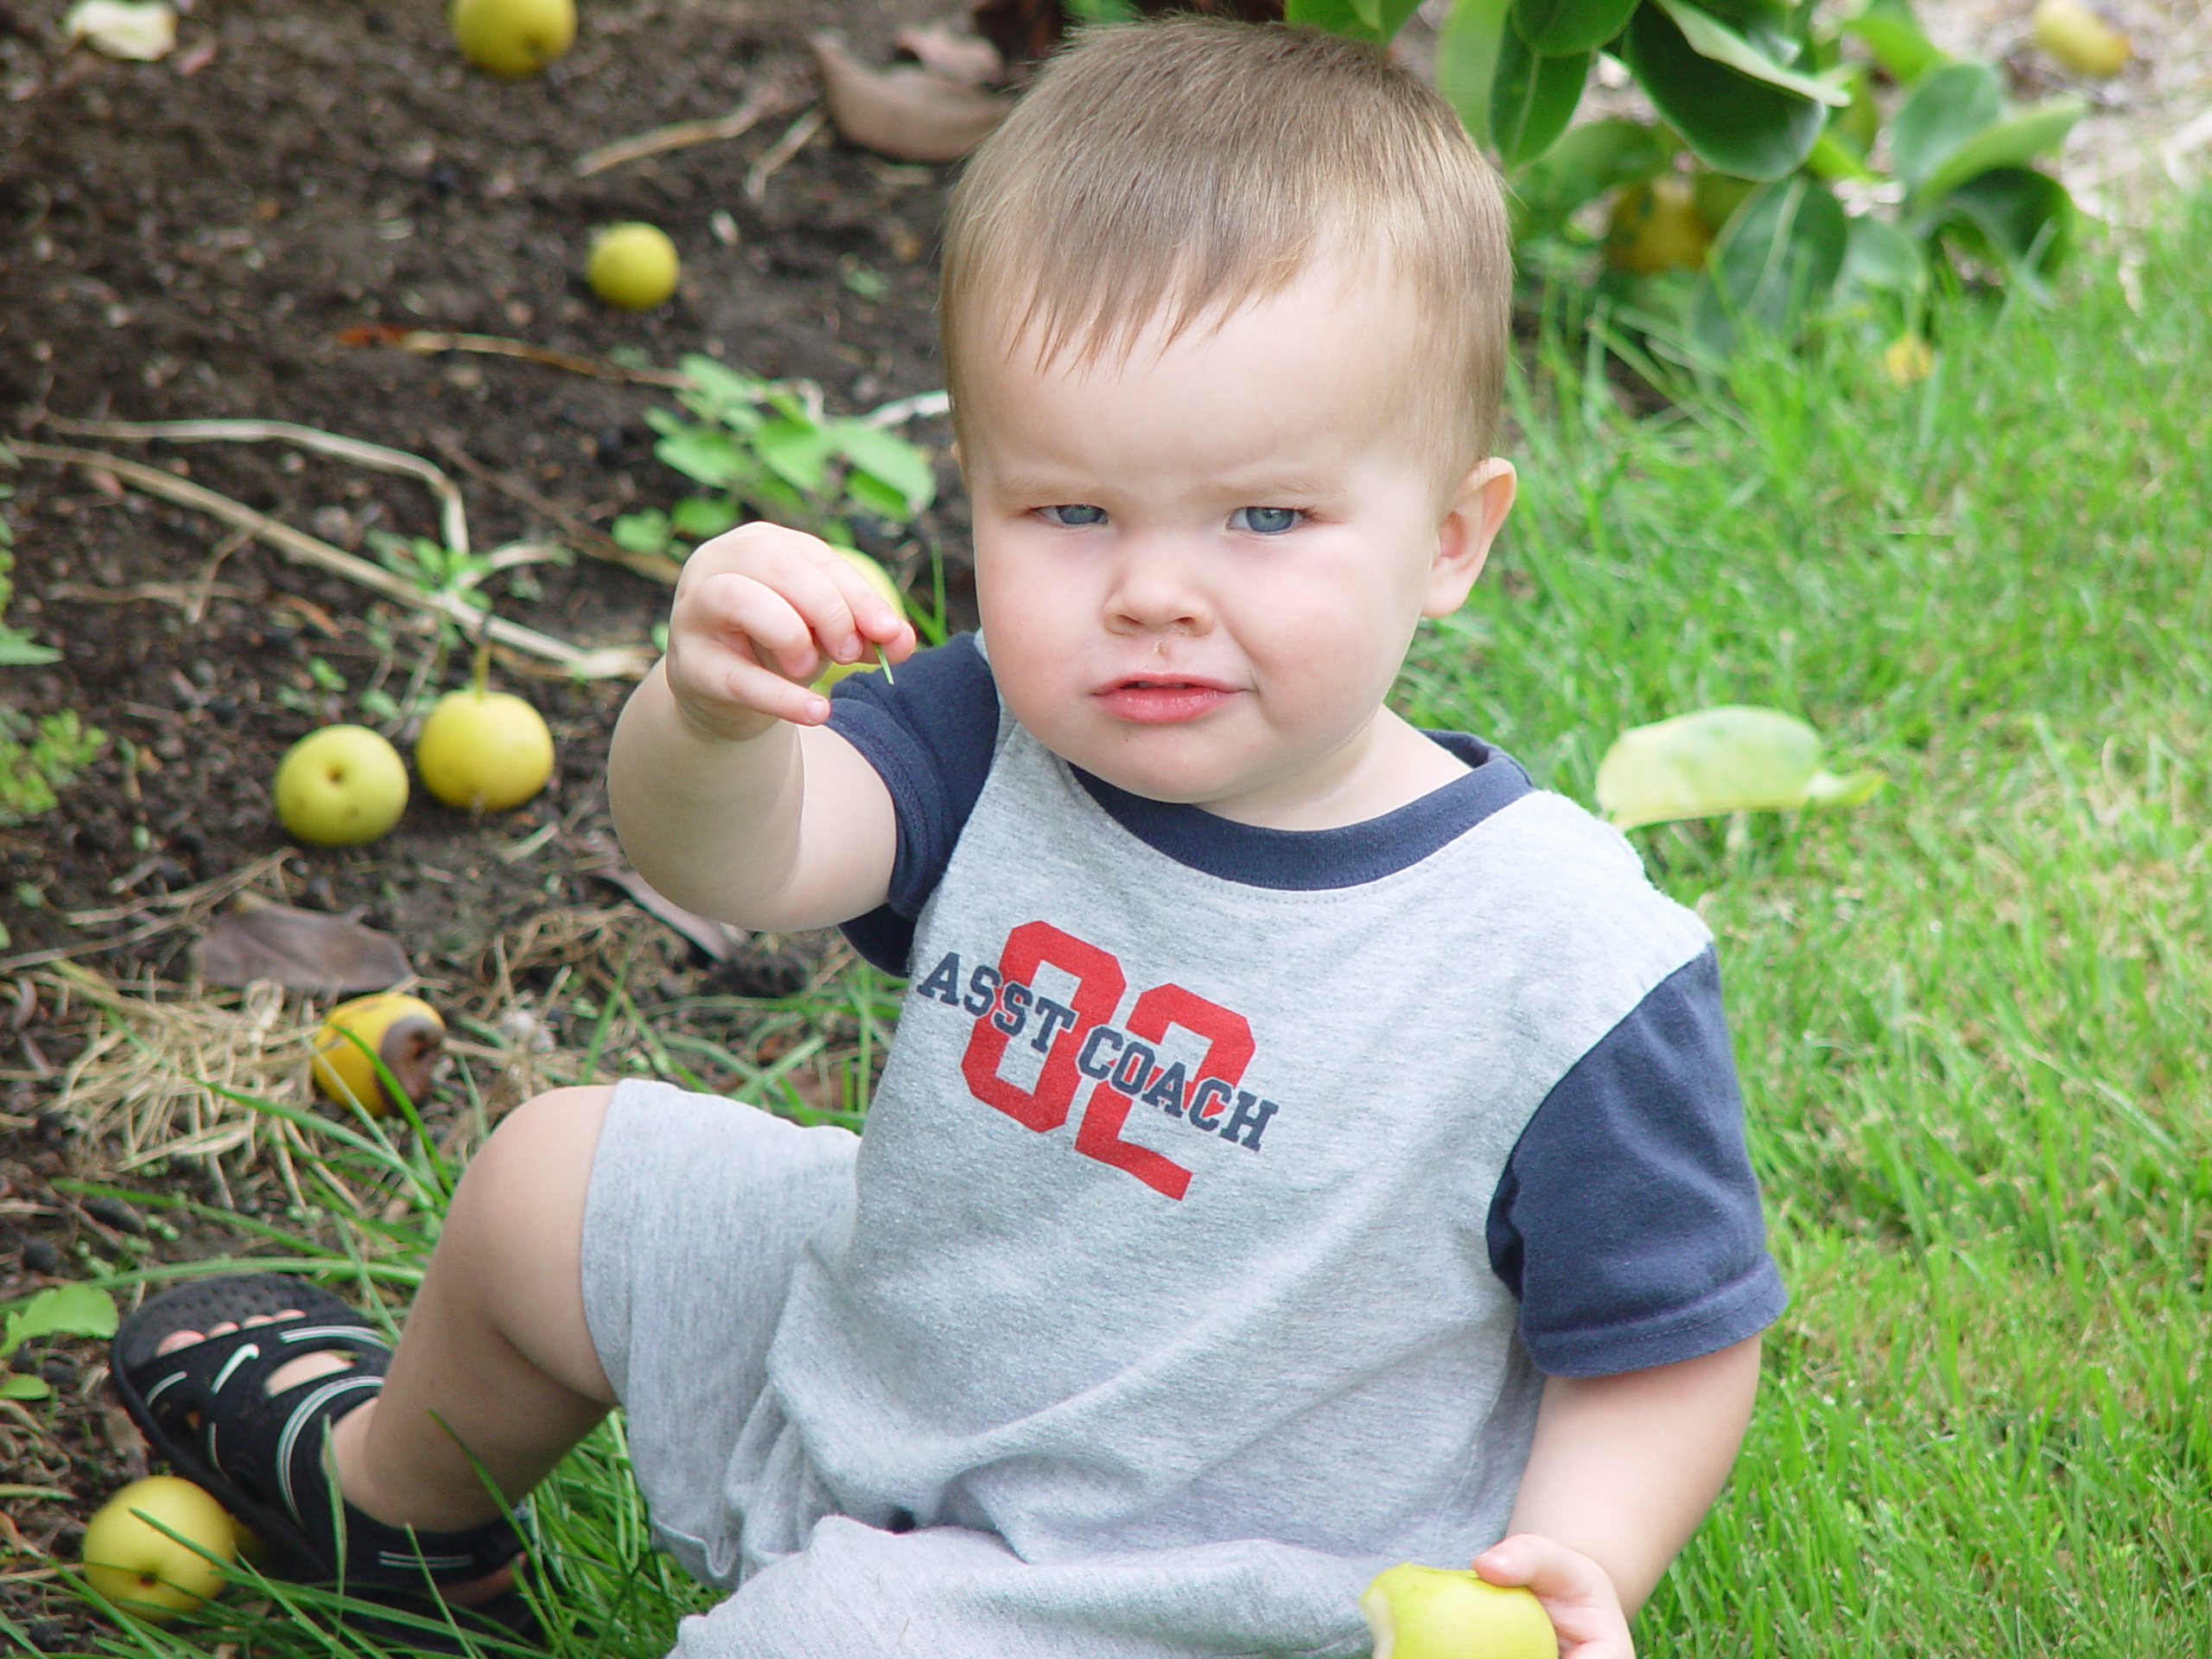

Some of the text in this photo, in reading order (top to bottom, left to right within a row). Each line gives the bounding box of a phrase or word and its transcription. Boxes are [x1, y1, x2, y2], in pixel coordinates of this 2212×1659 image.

[916, 951, 1280, 1152] ASST COACH
[961, 920, 1255, 1201] 02
